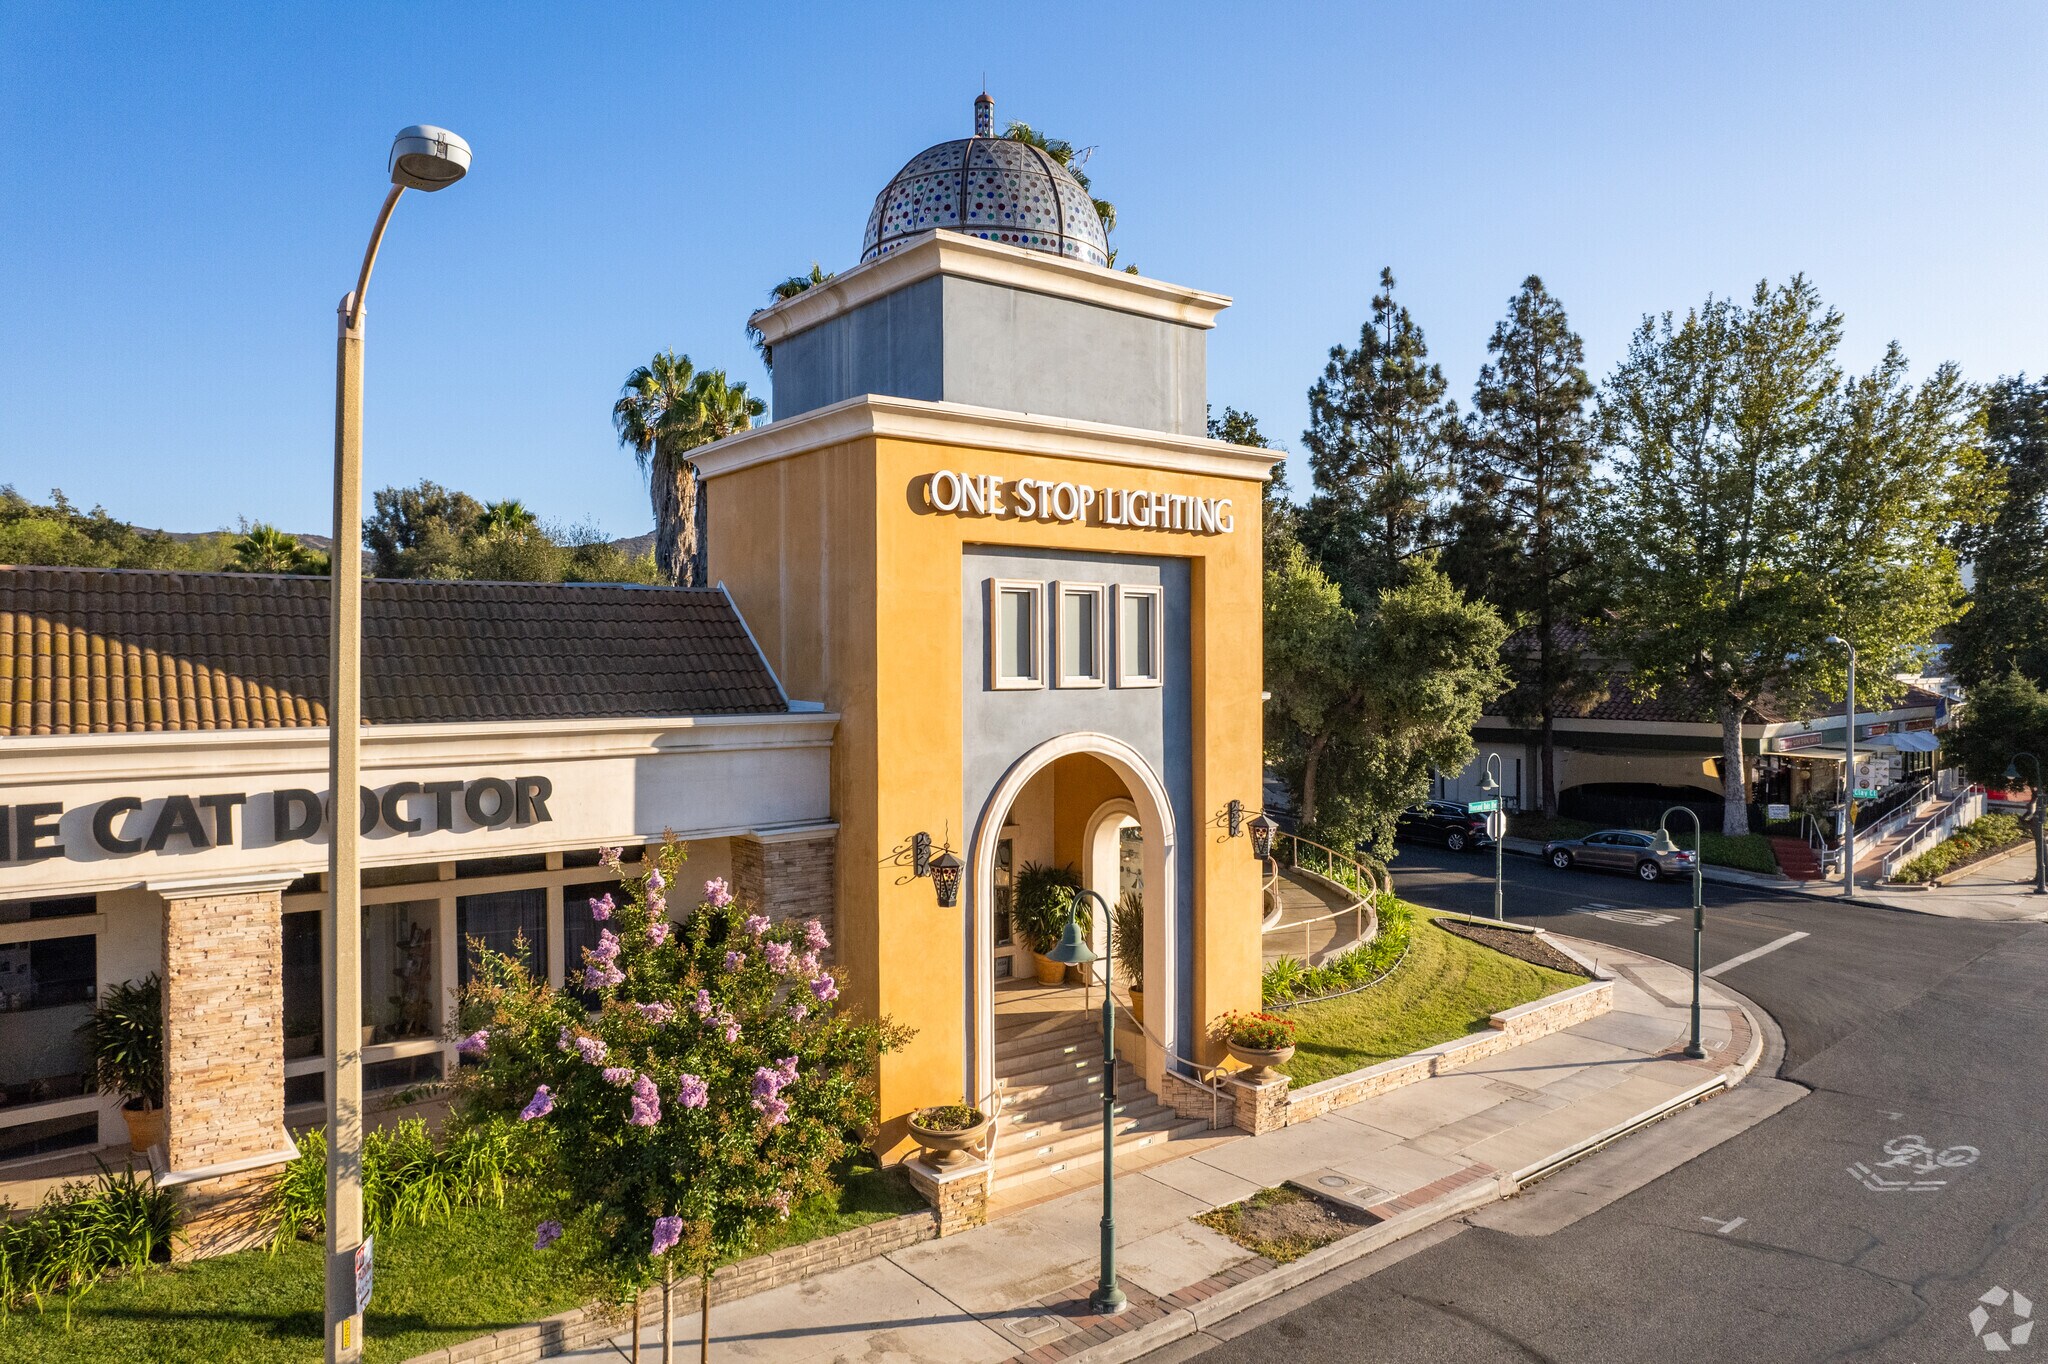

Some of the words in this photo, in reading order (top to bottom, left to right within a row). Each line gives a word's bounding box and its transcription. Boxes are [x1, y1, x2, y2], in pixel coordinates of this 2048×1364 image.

[929, 469, 1006, 515] ONE
[1014, 477, 1095, 521] STOP
[1103, 487, 1234, 533] LIGHTING
[1855, 788, 1868, 797] Clay
[0, 802, 65, 861] E
[93, 793, 246, 853] CAT
